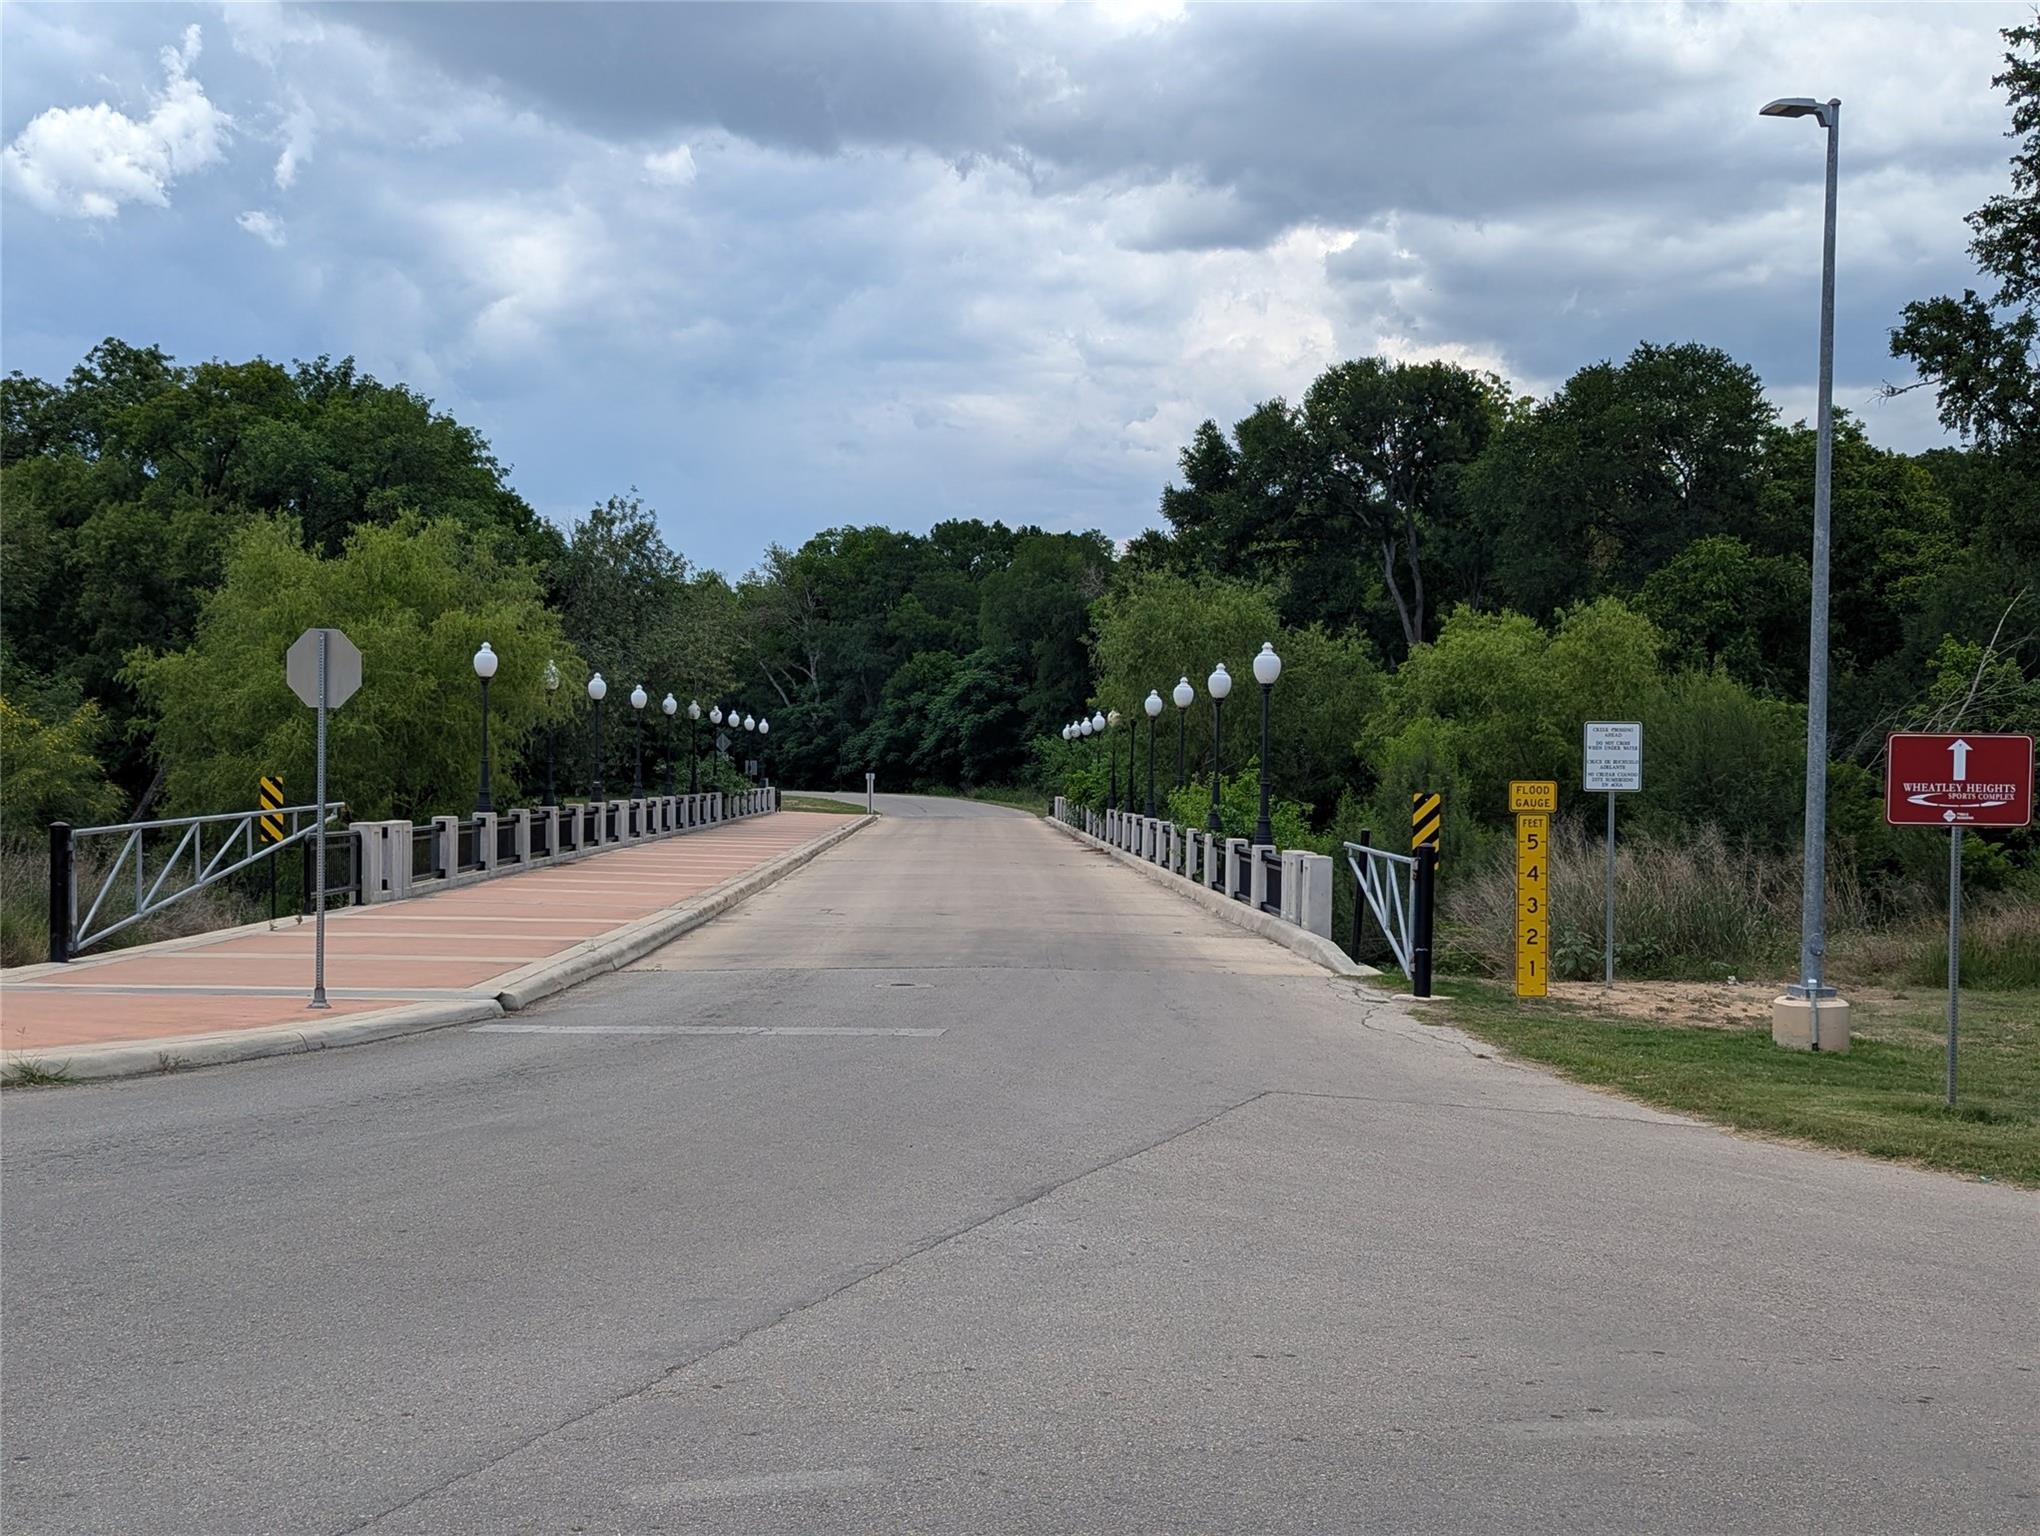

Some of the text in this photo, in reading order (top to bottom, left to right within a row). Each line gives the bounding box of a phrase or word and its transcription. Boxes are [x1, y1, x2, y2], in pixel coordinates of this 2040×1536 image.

[1516, 785, 1550, 795] FLOOD
[1902, 782, 2016, 793] WHEATLEY HEIGHTS
[1515, 798, 1551, 808] GAUGE
[1978, 793, 2015, 801] COMPLEX
[1522, 819, 1544, 828] FEET
[1527, 834, 1539, 850] 5
[1526, 865, 1539, 882] 4
[1527, 897, 1538, 914] 3
[1526, 928, 1538, 945] 2
[1530, 960, 1535, 976] 1
